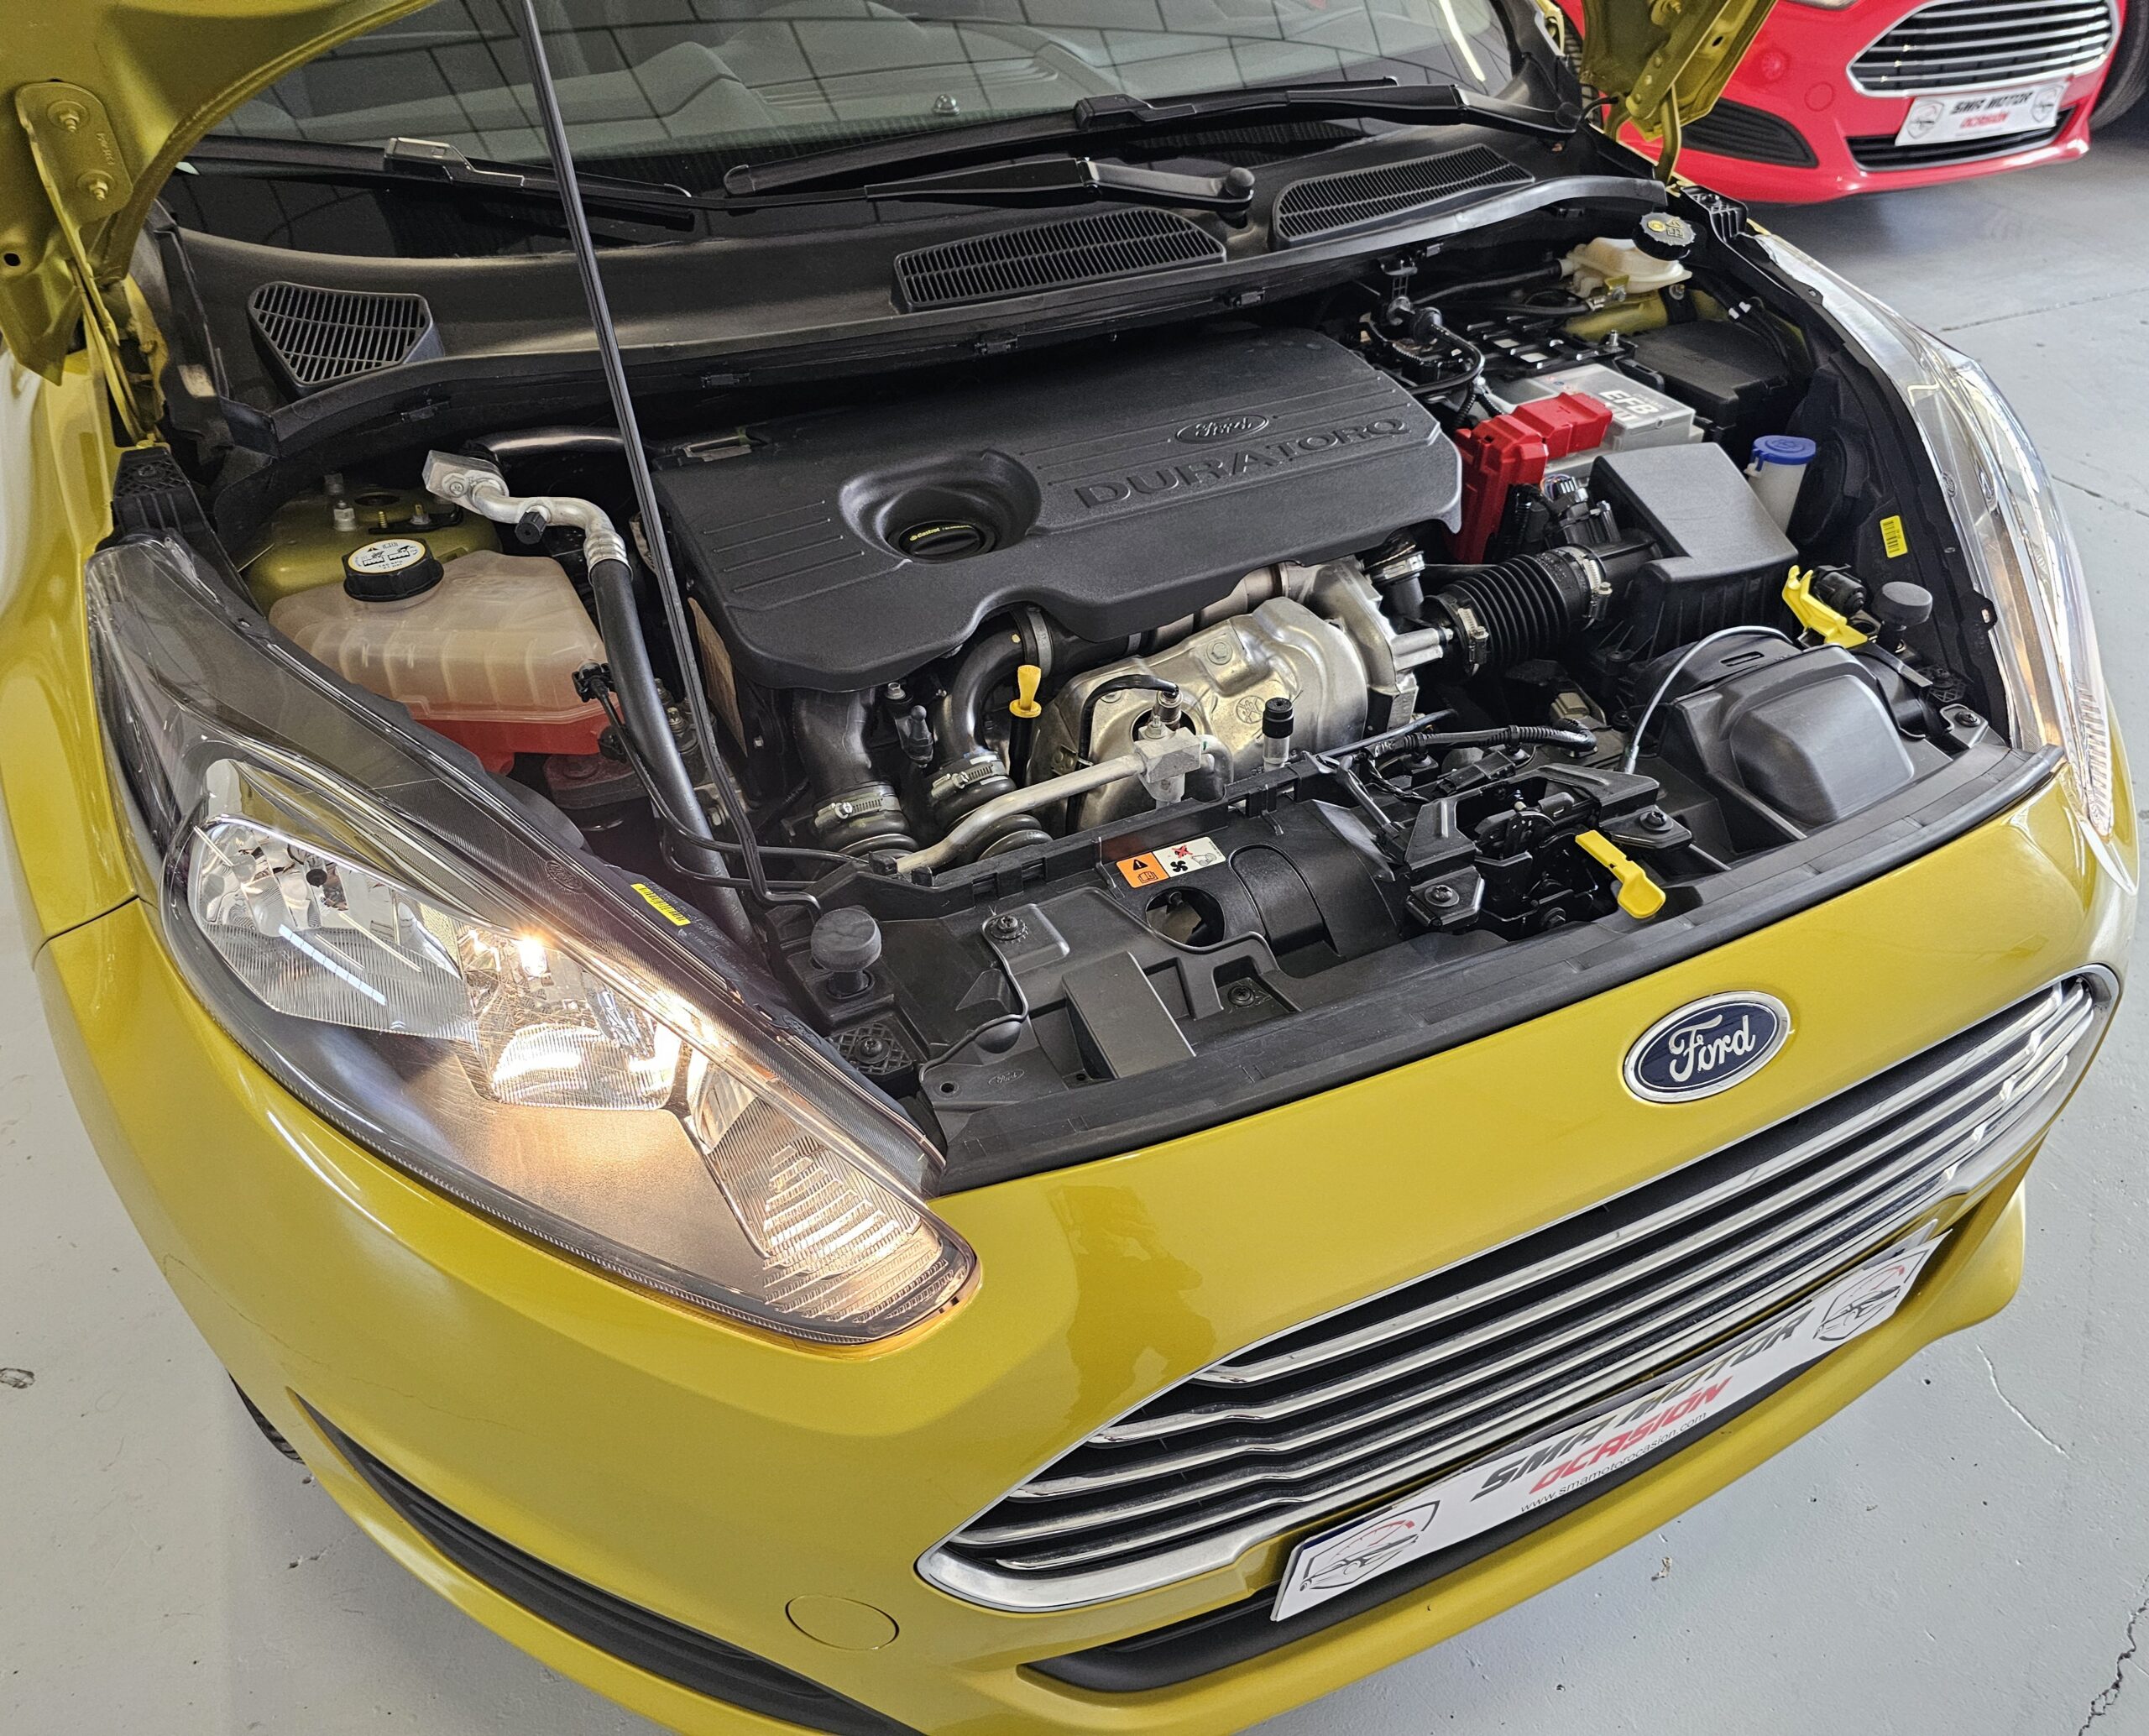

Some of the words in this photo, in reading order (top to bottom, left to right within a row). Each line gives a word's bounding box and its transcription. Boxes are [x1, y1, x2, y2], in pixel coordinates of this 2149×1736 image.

[1195, 417, 1252, 437] Ford
[1599, 390, 1660, 414] EFB
[1073, 418, 1412, 509] DURATORQ
[1667, 1014, 1756, 1083] Ford
[1470, 1414, 1618, 1502] SMA
[1614, 1307, 1815, 1428] MOTOR
[1520, 1411, 1707, 1513] www.smamotorocasion.com
